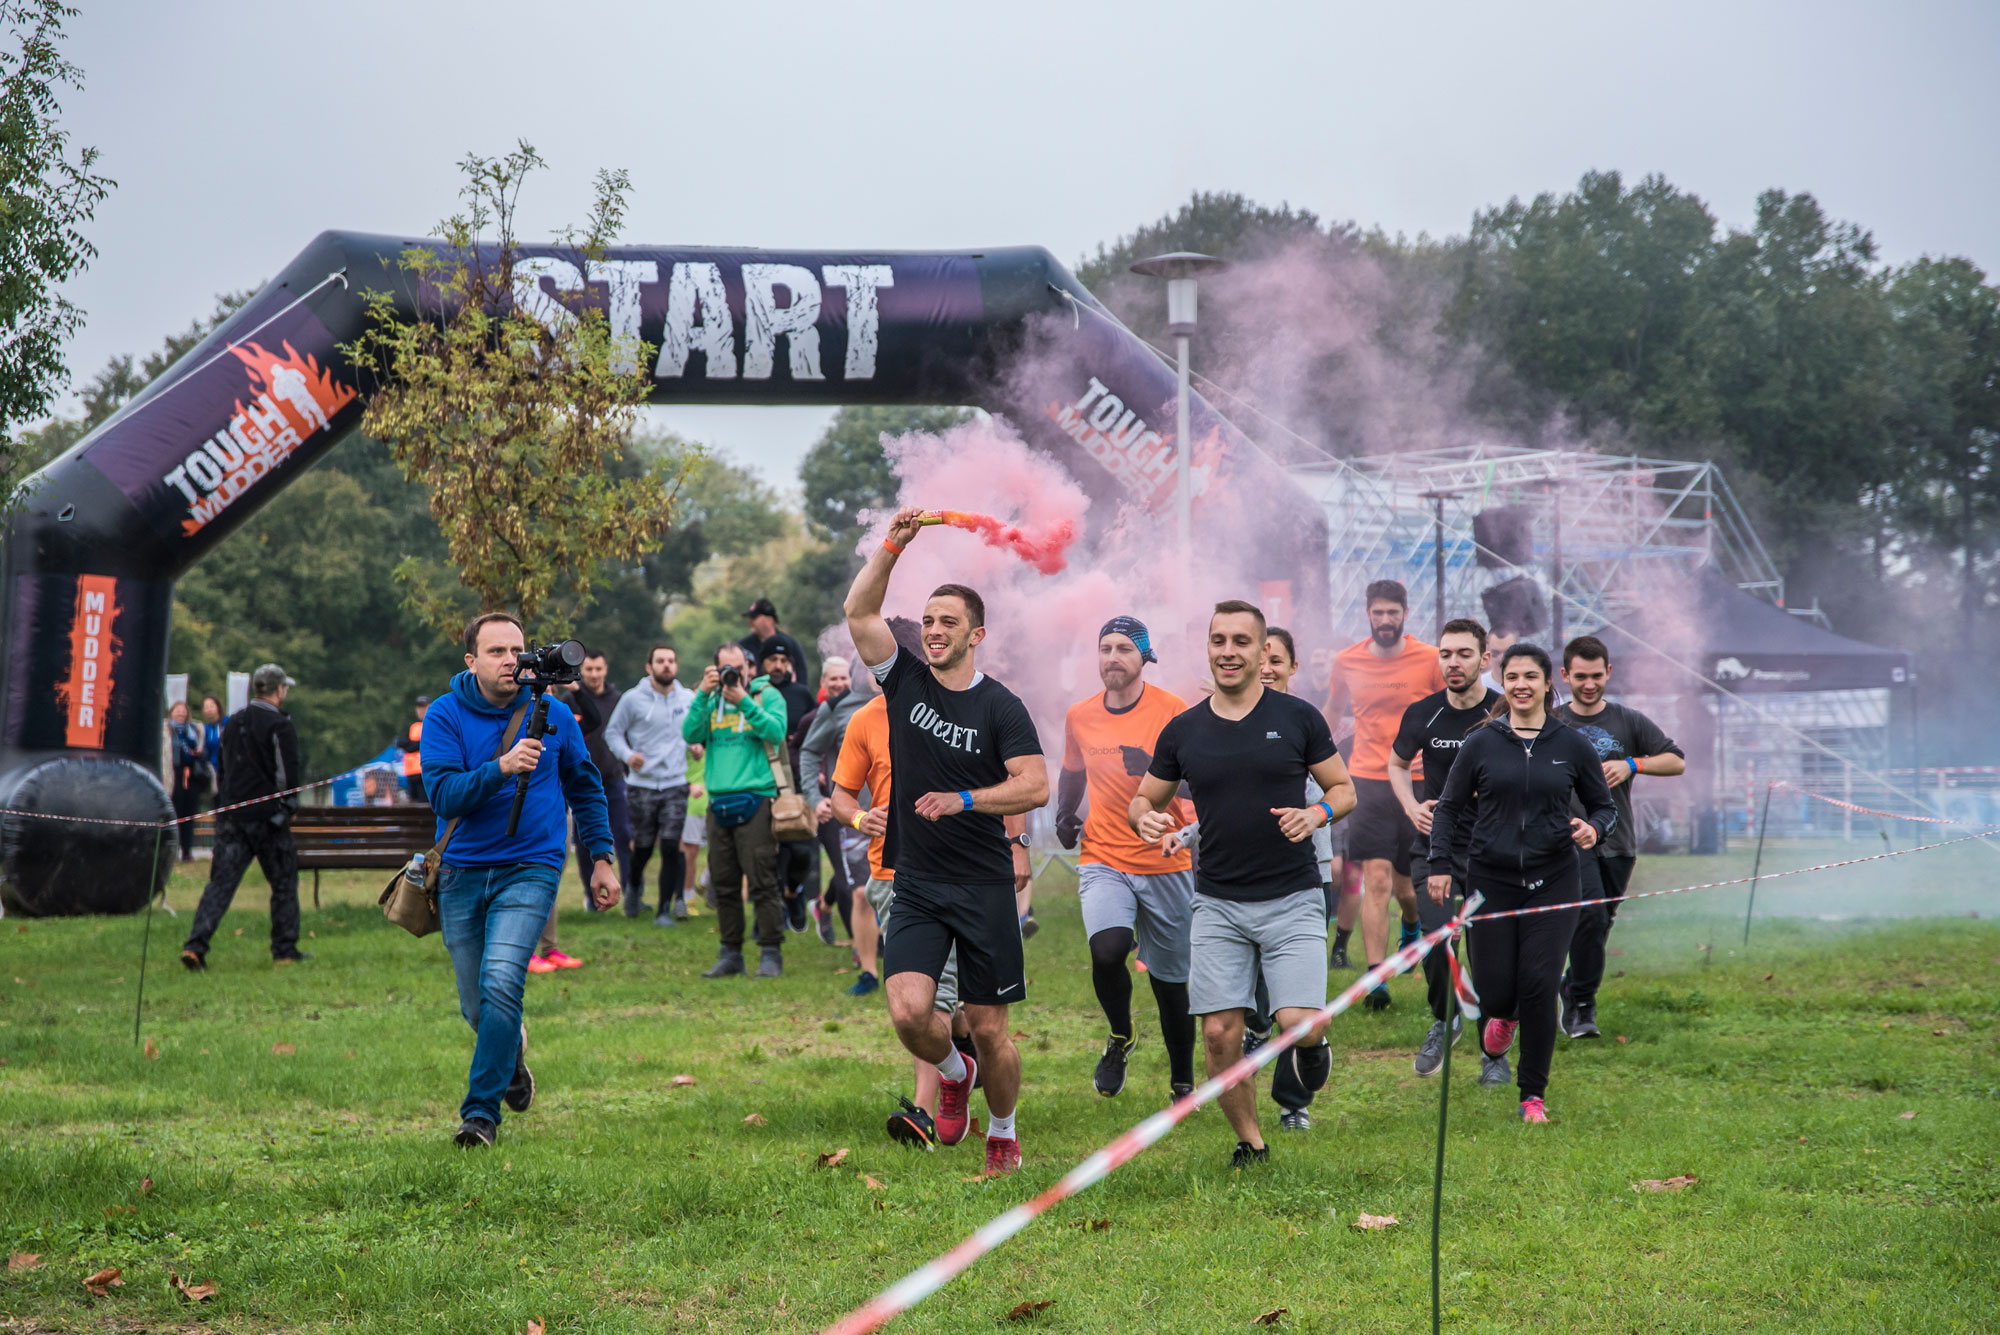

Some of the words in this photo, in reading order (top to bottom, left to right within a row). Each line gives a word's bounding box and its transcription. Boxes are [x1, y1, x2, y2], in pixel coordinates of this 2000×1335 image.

[511, 256, 894, 381] START
[163, 392, 290, 505] TOUGH
[188, 427, 303, 525] MUDDER
[1075, 376, 1178, 488] TOUGH
[78, 590, 105, 728] MUDDER
